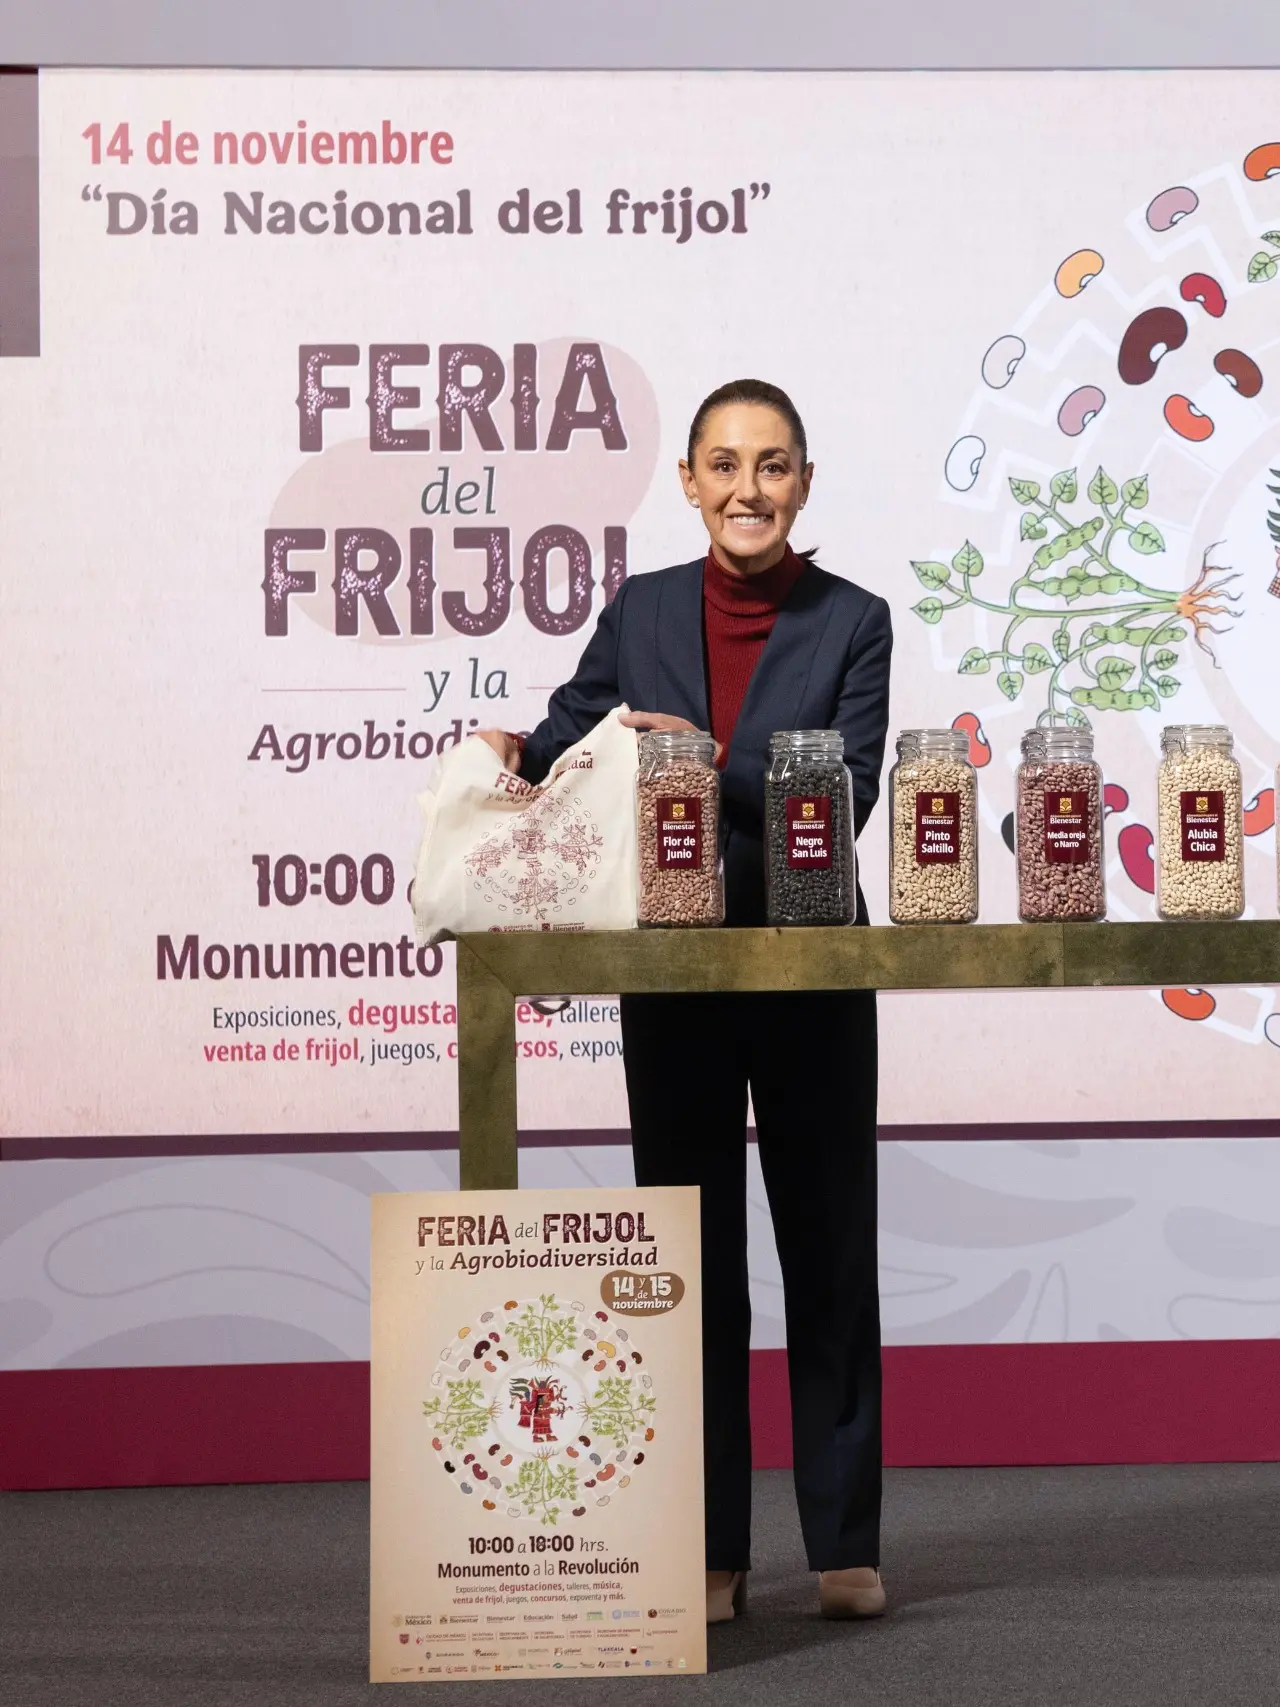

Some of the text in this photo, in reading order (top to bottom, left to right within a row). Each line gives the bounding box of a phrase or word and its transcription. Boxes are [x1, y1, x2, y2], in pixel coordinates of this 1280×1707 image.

[82, 121, 454, 165] 14 de noviembre
[224, 191, 473, 235] Nacional
[499, 189, 582, 234] del
[296, 342, 628, 452] FERIA
[420, 467, 497, 514] del
[423, 657, 509, 711] y la
[664, 836, 695, 846] Flor de
[926, 831, 950, 840] Pinto
[1048, 831, 1085, 840] Media oreja
[1188, 829, 1218, 839] Alubia
[796, 837, 823, 848] Negro
[922, 843, 953, 853] Saltillo
[1191, 841, 1216, 851] Chica
[666, 849, 692, 861] Junio
[792, 848, 827, 858] San Luis
[253, 853, 395, 907] 10:00
[156, 934, 443, 979] Monumento
[213, 1006, 342, 1032] Exposiciones,
[560, 1003, 619, 1022] tallere
[204, 1041, 266, 1062] venta
[273, 1039, 299, 1061] de
[306, 1037, 364, 1067] frijol,
[371, 1037, 442, 1067] juegos,
[418, 1212, 655, 1246] FERIA del FRIJOL
[415, 1247, 658, 1275] y la Agrobiodiversidad
[612, 1276, 672, 1297] 14 y 15
[637, 1290, 648, 1299] de
[612, 1298, 673, 1309] noviembre
[468, 1535, 609, 1554] 10:00 a 18:00 hrs.
[438, 1557, 639, 1578] Monumento a la Revolución
[499, 1582, 565, 1594] degustaciones,
[593, 1580, 623, 1590] música,
[475, 1596, 484, 1604] de
[405, 1618, 432, 1626] México
[524, 1613, 554, 1621] Educación
